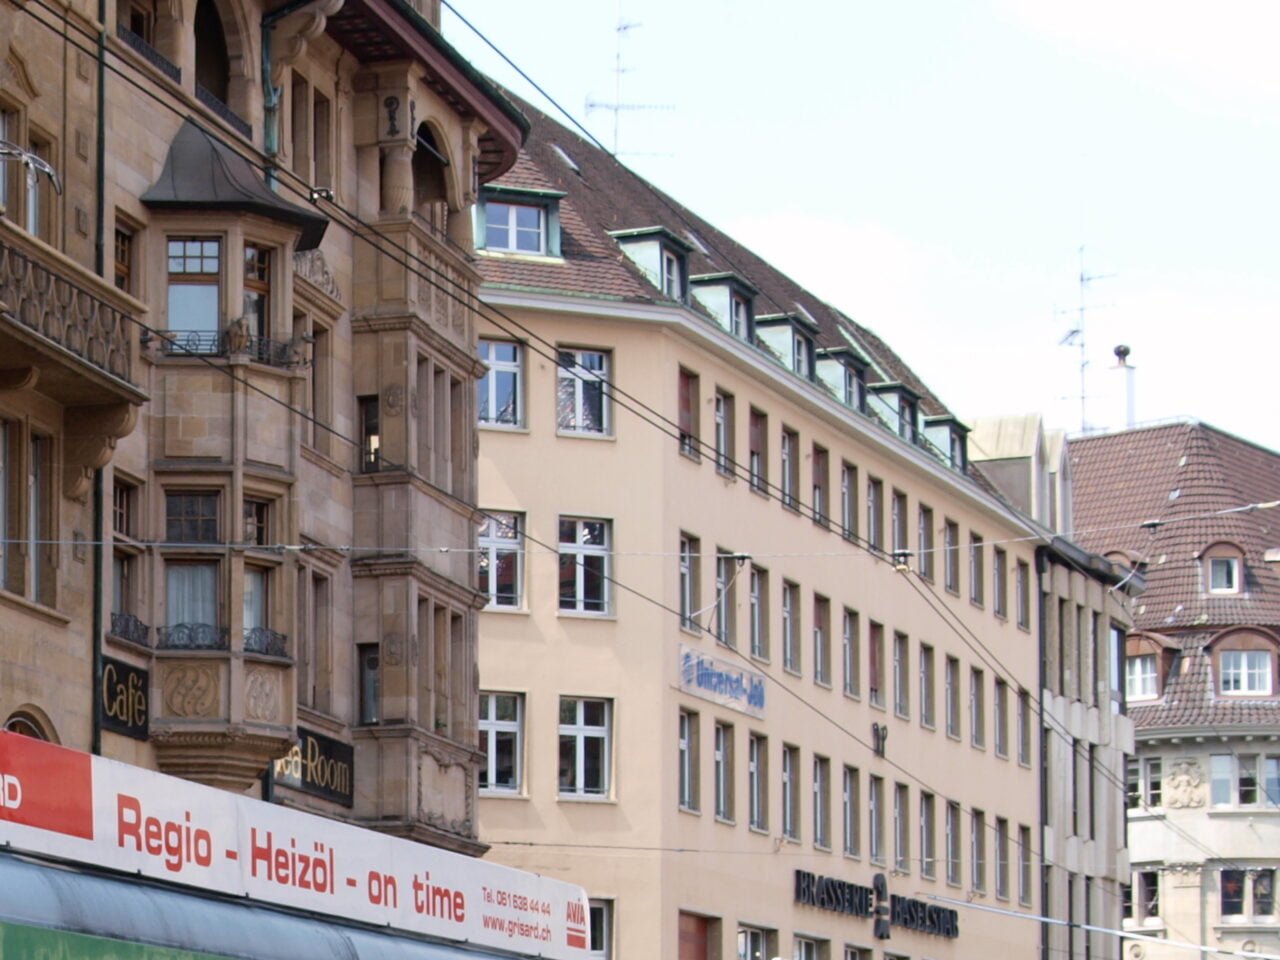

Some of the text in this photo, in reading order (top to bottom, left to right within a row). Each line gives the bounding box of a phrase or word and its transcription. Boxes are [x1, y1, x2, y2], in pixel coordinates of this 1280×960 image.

[101, 662, 146, 727] Café
[117, 793, 212, 873] Regio
[251, 827, 335, 895] Heizöl
[368, 870, 397, 909] on
[413, 871, 465, 923] time
[482, 886, 495, 904] Tel.
[496, 889, 512, 908] 061
[529, 899, 540, 915] 44
[540, 901, 551, 916] 44
[566, 899, 586, 925] AVIA
[794, 869, 874, 918] BRASSERIE
[482, 914, 552, 942] www.grisard.ch
[889, 894, 960, 939] BASELSTAB
